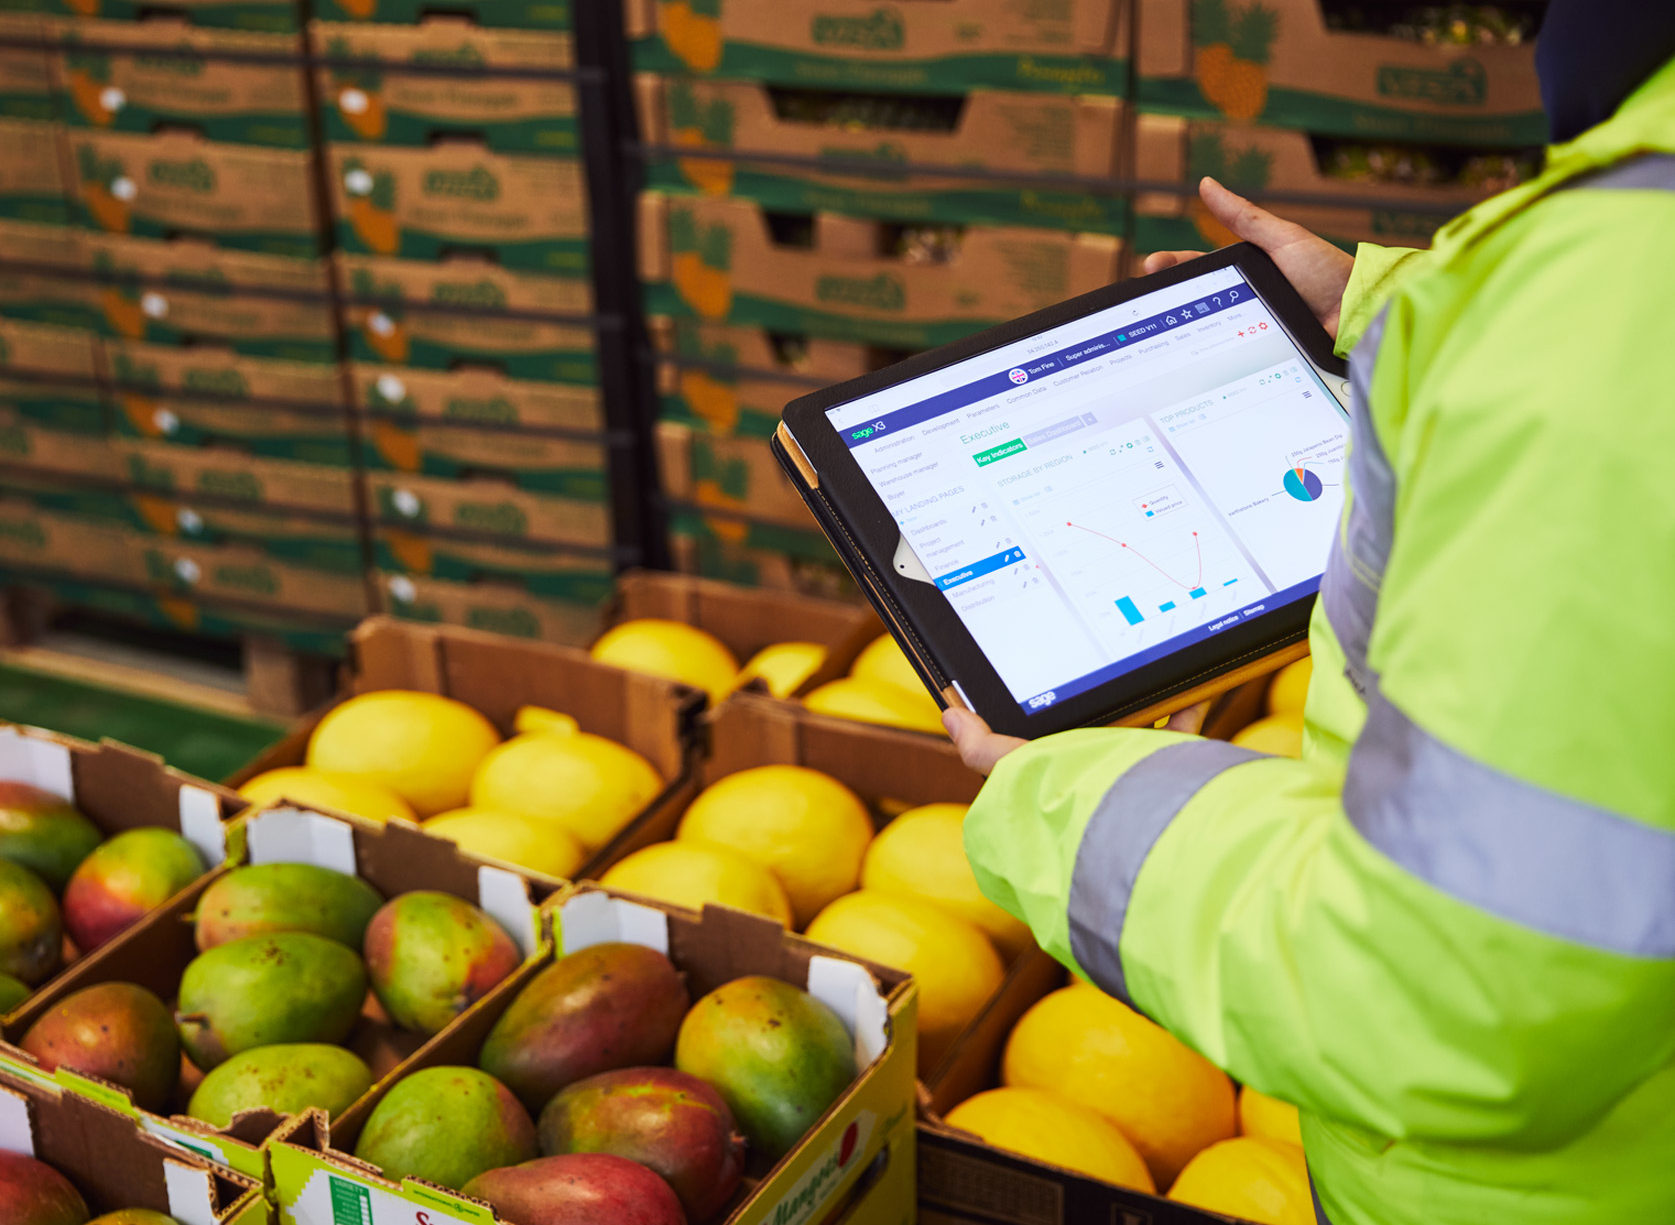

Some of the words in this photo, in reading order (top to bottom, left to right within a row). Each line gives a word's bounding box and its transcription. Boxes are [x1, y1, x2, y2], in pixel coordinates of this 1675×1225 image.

[1129, 328, 1146, 338] SEED
[1065, 352, 1083, 362] Super
[1028, 366, 1042, 375] Tom
[1042, 361, 1055, 371] Fine
[875, 435, 915, 453] Administration
[922, 418, 960, 436] Development
[966, 404, 1000, 419] Parameters
[1006, 391, 1032, 404] Common
[1032, 386, 1047, 395] Data
[1053, 374, 1080, 387] Customer
[1160, 413, 1174, 424] TOP
[1174, 400, 1214, 418] PRODUCTS
[851, 427, 874, 440] sage
[872, 421, 886, 432] X3
[960, 421, 1010, 445] Executive
[976, 453, 991, 464] Key
[991, 442, 1023, 458] Indicators
[871, 459, 897, 474] Planning
[897, 452, 923, 467] manager
[997, 469, 1033, 488] STORAGE
[1033, 464, 1045, 475] BY
[1044, 454, 1074, 471] REGION
[880, 472, 912, 487] Warehouse
[913, 462, 938, 477] manager
[887, 490, 905, 501] Buyer
[904, 495, 939, 514] LANDING
[938, 485, 965, 500] PAGES
[911, 519, 947, 536] Dashboards
[919, 537, 942, 550] Project
[926, 540, 965, 558] management
[943, 570, 973, 586] Executive
[952, 579, 996, 599] Manufacturing
[1208, 621, 1224, 632] Legal
[1223, 615, 1239, 625] notice
[1243, 604, 1265, 616] Sitemap
[1028, 691, 1056, 708] sage
